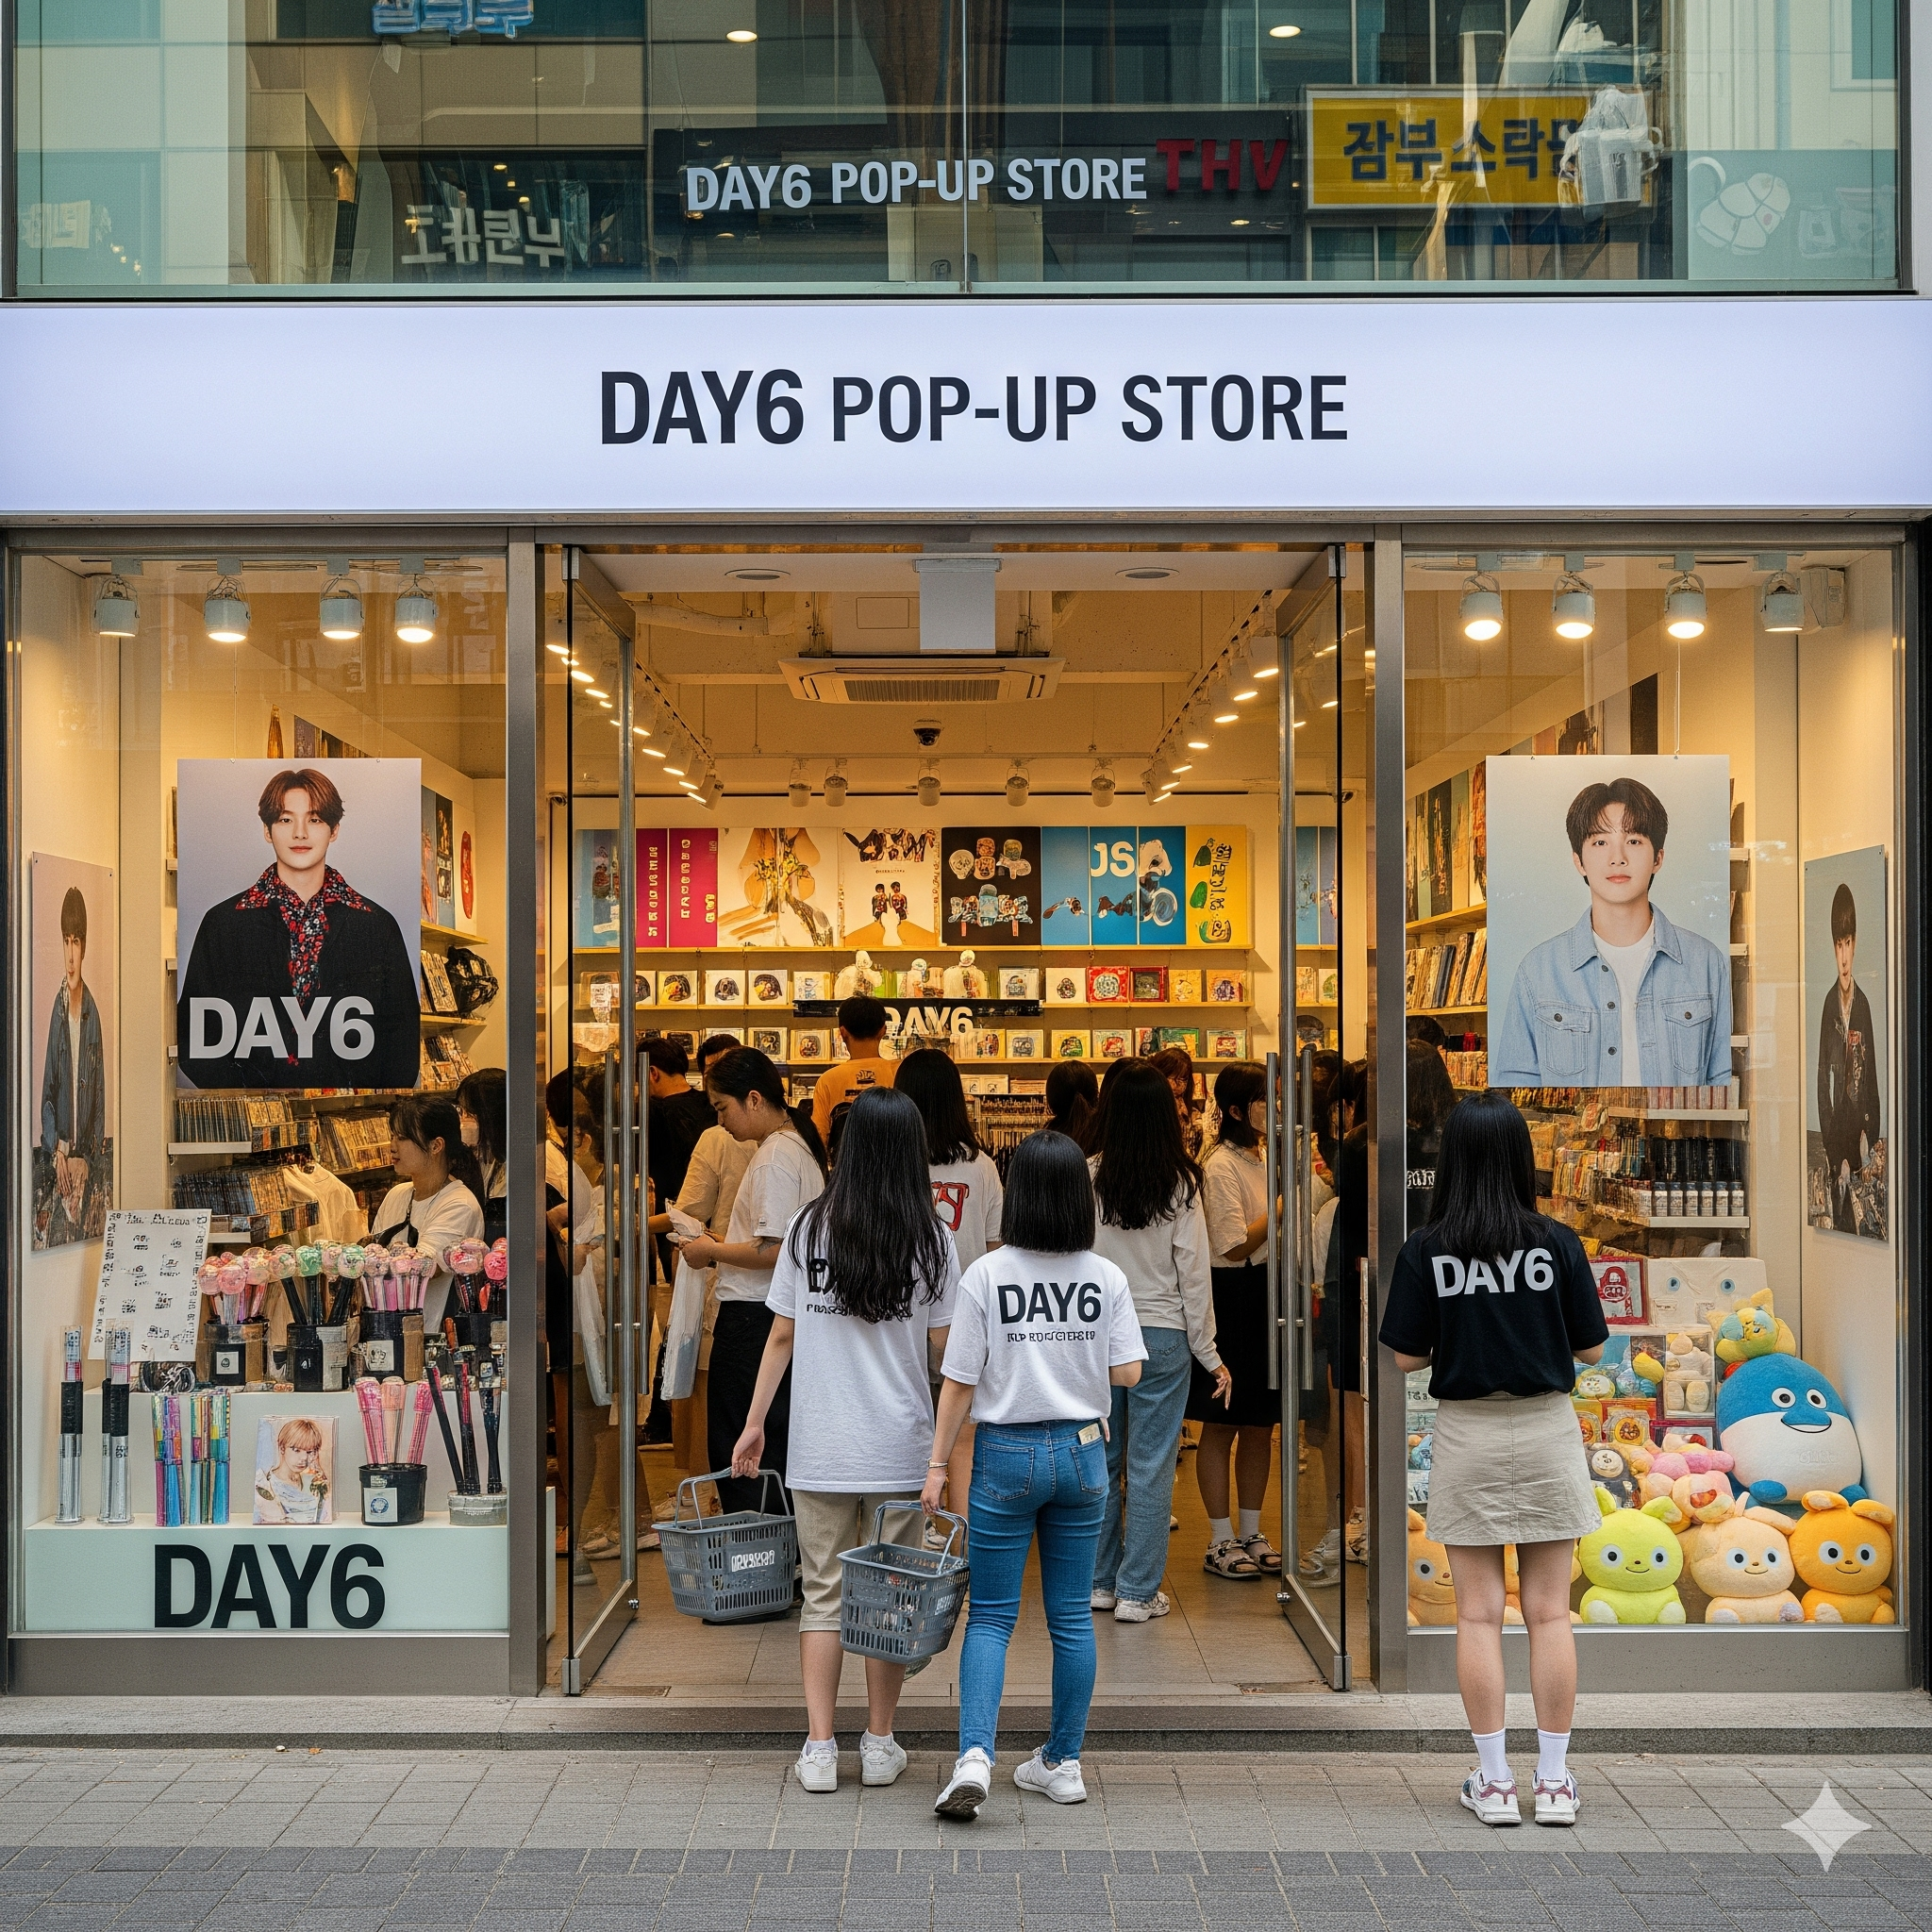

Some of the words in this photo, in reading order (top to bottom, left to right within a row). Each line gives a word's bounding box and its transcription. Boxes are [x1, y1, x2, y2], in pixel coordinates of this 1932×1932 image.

[686, 163, 811, 211] DAY6
[831, 159, 994, 204] POP-UP
[1007, 158, 1147, 201] STORE
[1157, 138, 1289, 192] THV
[601, 368, 804, 445] DAY6
[832, 375, 1096, 443] POP-UP
[1121, 374, 1348, 442] STORE
[189, 996, 375, 1060] DAY6
[1431, 1247, 1555, 1298] DAY6
[996, 1282, 1102, 1324] DAY6
[154, 1543, 386, 1630] DAY6
